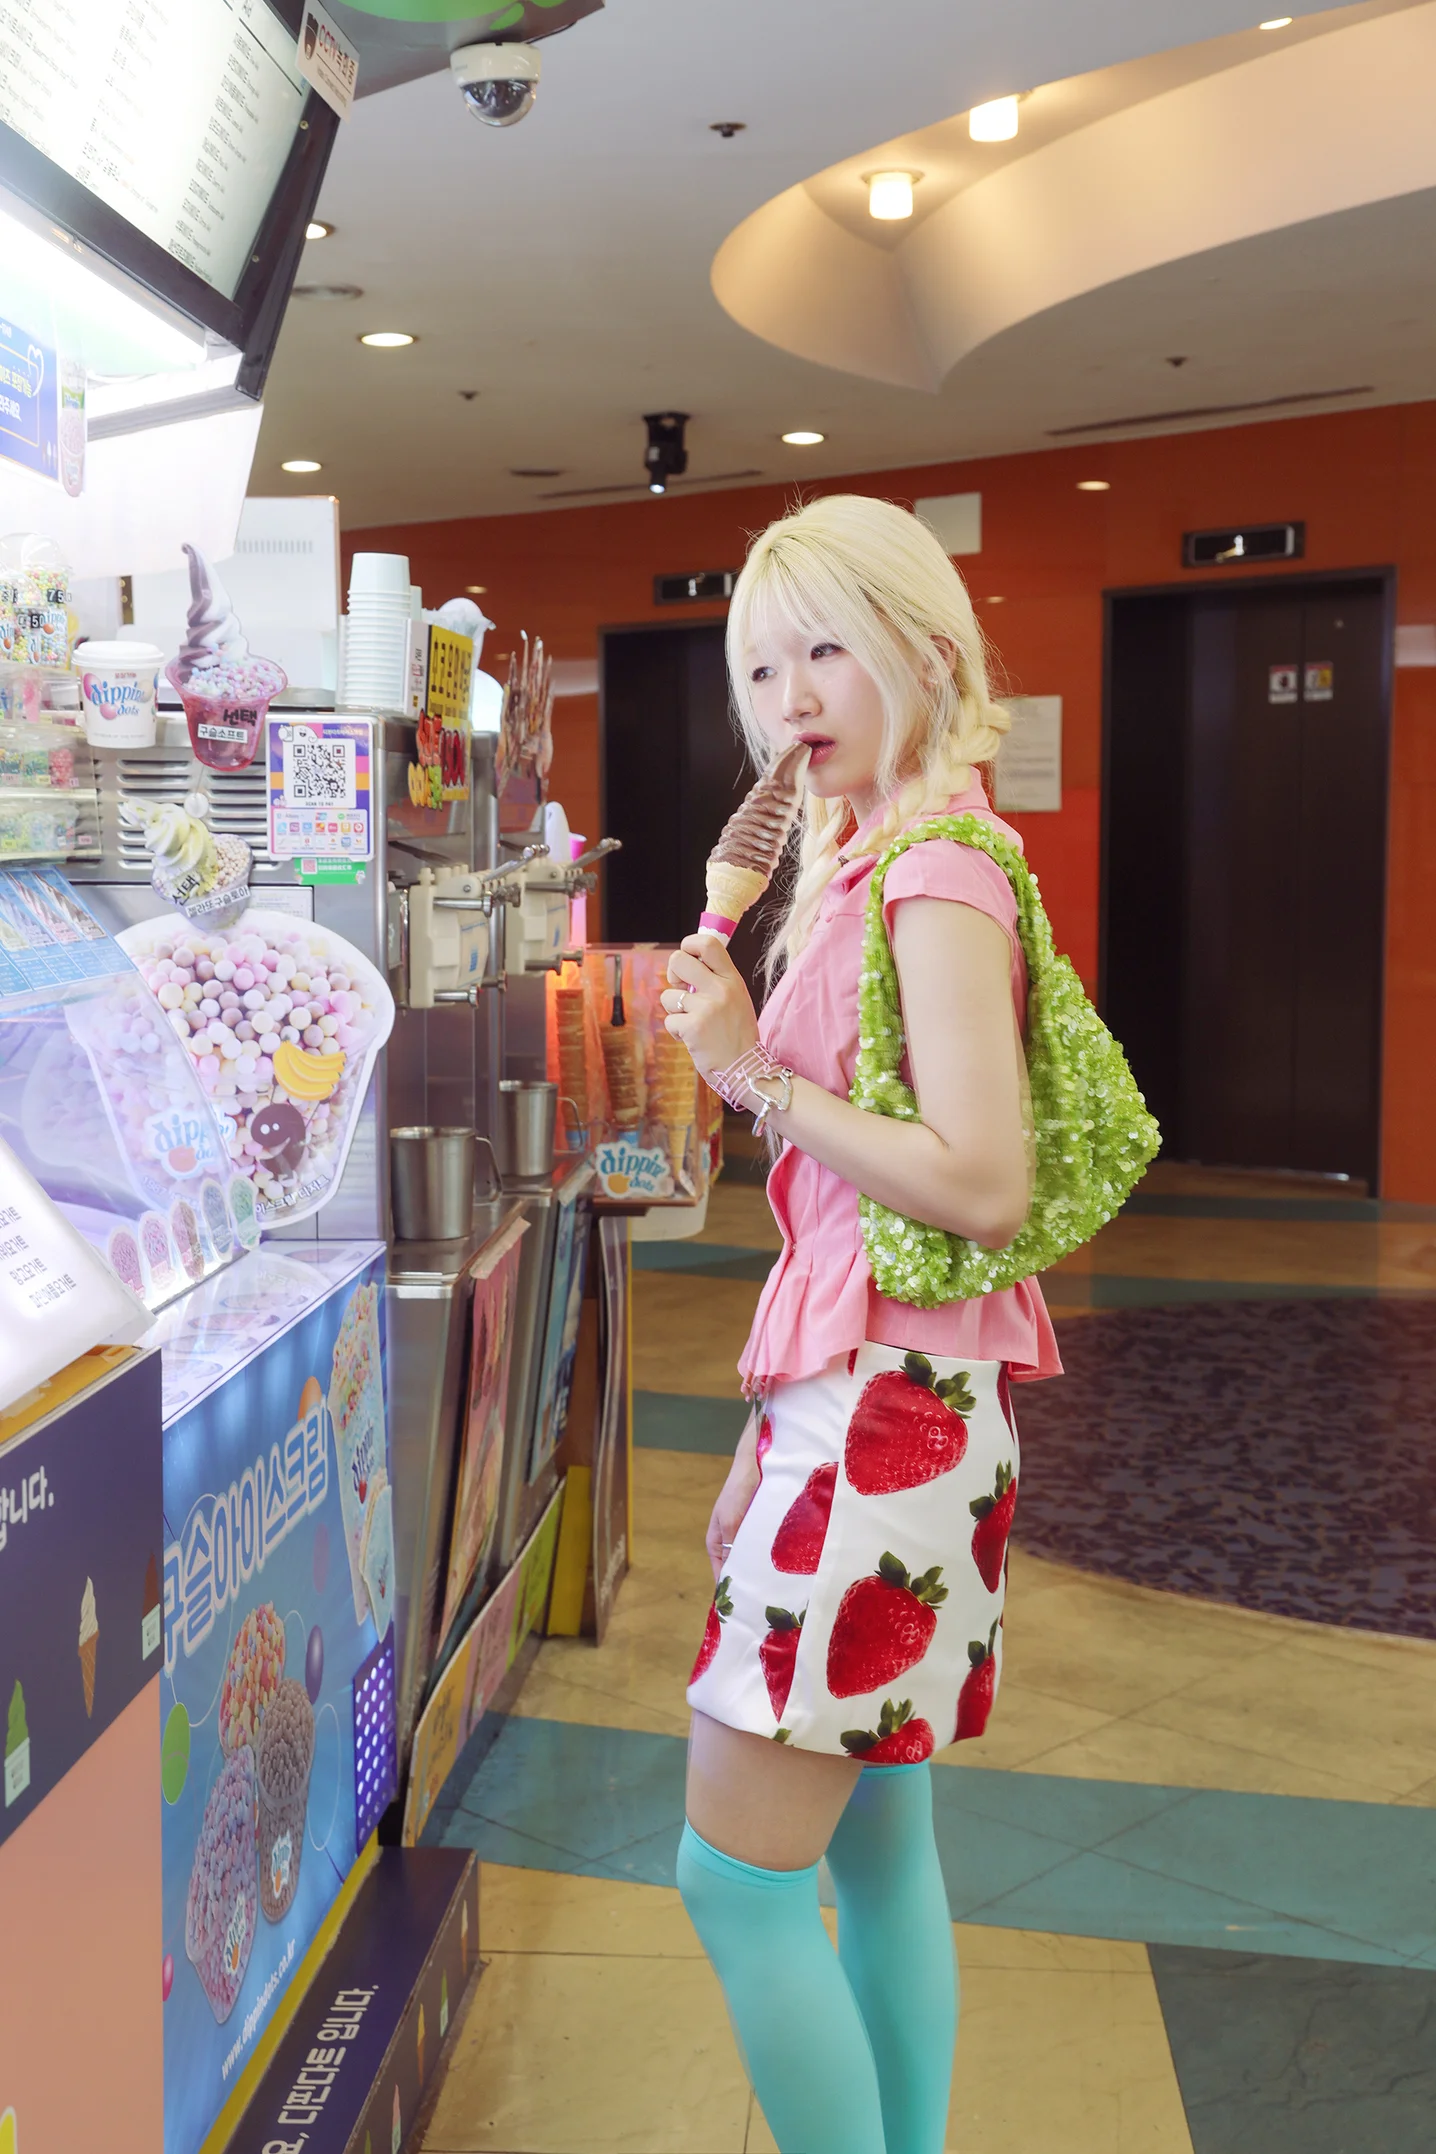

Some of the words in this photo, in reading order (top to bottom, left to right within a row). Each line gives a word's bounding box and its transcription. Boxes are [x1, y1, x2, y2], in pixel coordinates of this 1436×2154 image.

[116, 704, 140, 717] dots
[223, 708, 258, 728] 선택
[200, 726, 245, 741] 구슬소프트
[172, 874, 200, 906] 선택
[298, 1174, 331, 1199] 디저트
[9, 1258, 48, 1286] 망고요거트
[28, 1274, 77, 1308] 파인애플요거트
[163, 1396, 329, 1678] 구슬아이스크림
[278, 2047, 347, 2124] 디핀다트
[316, 1984, 380, 2041] 입니다.
